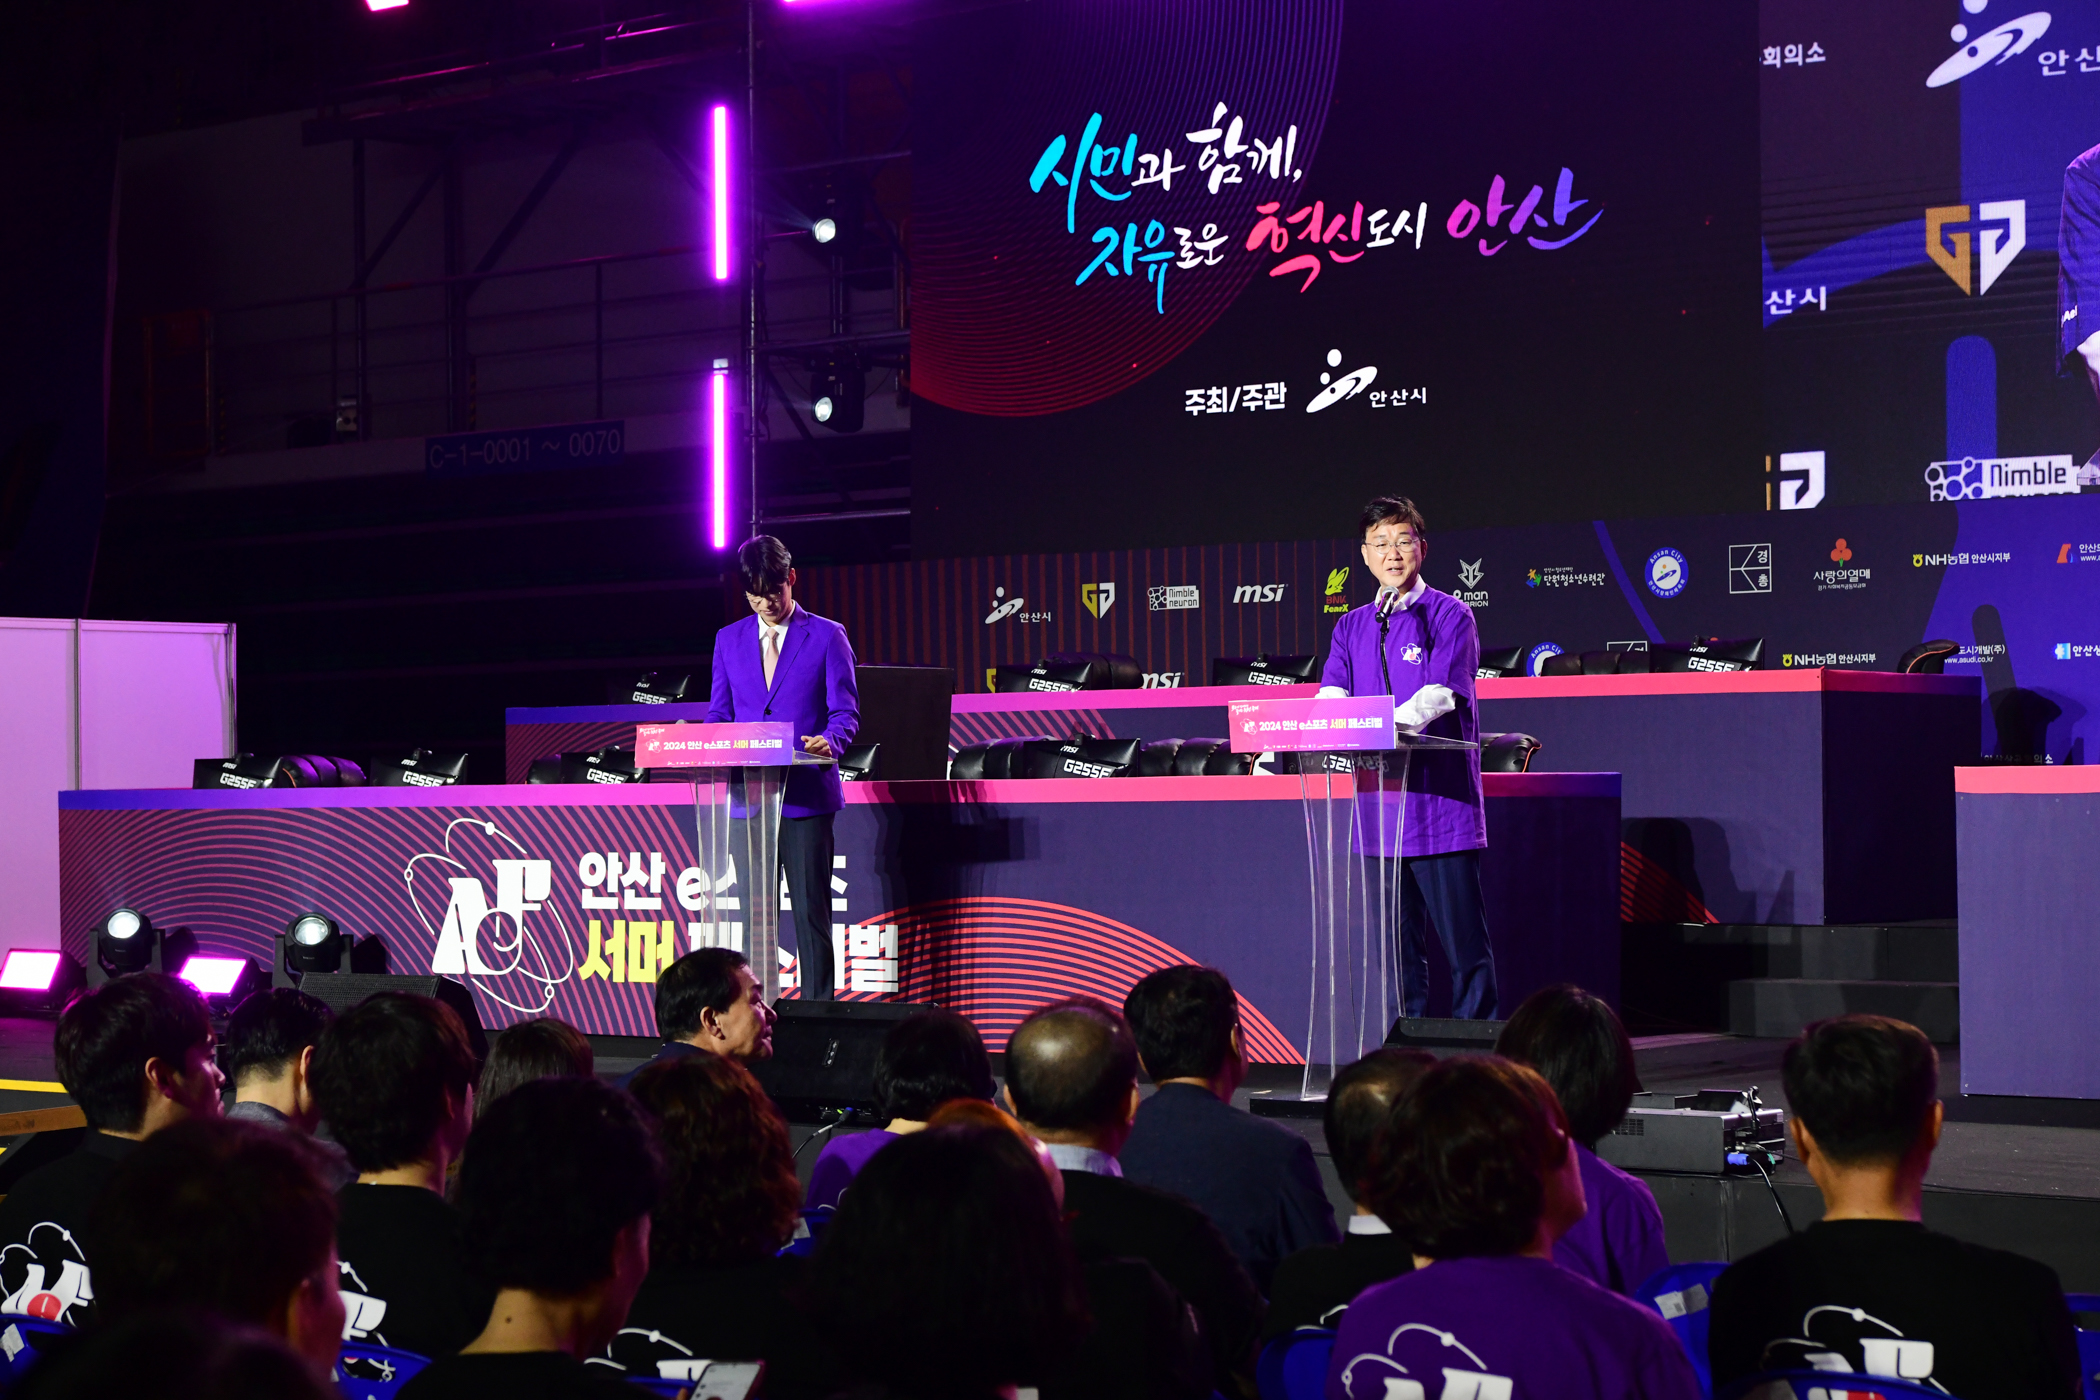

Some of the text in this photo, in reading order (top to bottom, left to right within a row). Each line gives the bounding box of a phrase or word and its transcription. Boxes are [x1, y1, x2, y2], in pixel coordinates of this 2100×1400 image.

[1762, 41, 1827, 69] 회의소
[1029, 101, 1304, 233] 시민과 함께,
[1075, 166, 1605, 315] 자유로운 혁신도시 안산
[1764, 285, 1827, 315] 산시
[1185, 382, 1288, 416] 주최/주관
[1369, 386, 1428, 409] 안산시
[429, 437, 530, 469] C-1-0001
[569, 429, 621, 457] 0070
[1990, 460, 2067, 488] Nimble
[1650, 549, 1684, 564] Ansan City
[1925, 552, 2011, 567] NH농협 안산시지부
[1543, 572, 1606, 588] 단원청소년수련관
[1813, 568, 1871, 584] 사랑의열매
[1168, 599, 1198, 608] neuron
[1326, 595, 1347, 604] BNK
[1324, 604, 1349, 613] FearX
[1019, 611, 1051, 623] 안산시
[1531, 644, 1550, 658] Ansan
[1794, 652, 1877, 667] NH농협 안산시지부
[1258, 717, 1383, 732] 2024 안산 e스포츠 서머 페스티벌
[663, 738, 783, 750] 2024 안산 e스포츠 서머 페스티벌
[578, 851, 666, 910] 안산
[577, 919, 675, 983] 서머
